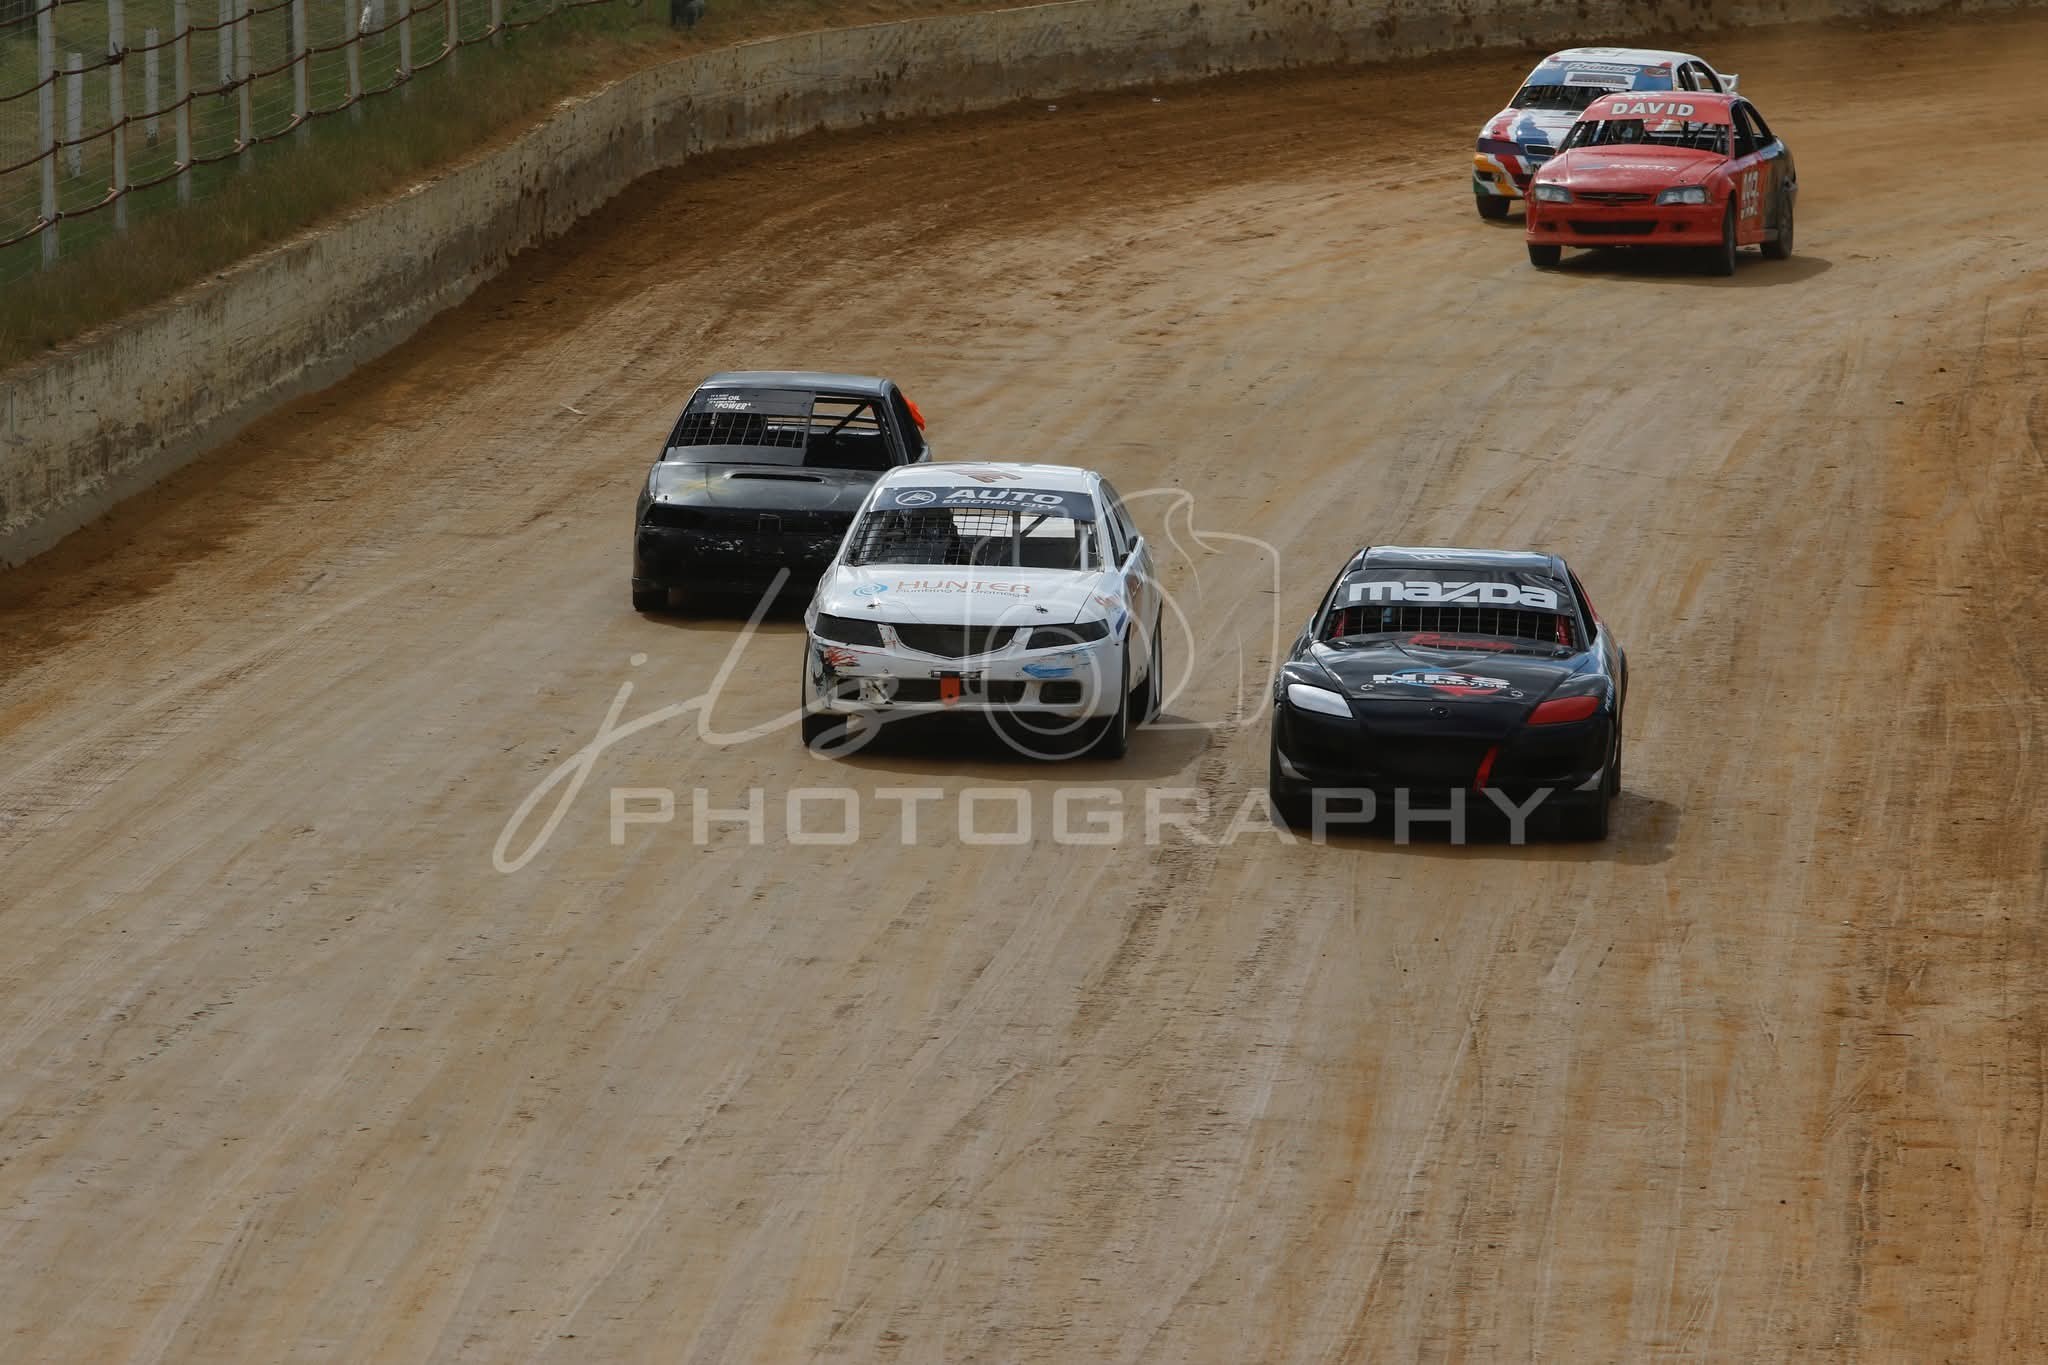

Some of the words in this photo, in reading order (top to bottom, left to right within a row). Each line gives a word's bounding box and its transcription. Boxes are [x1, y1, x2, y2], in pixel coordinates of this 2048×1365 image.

[1611, 102, 1695, 117] DAVID
[945, 488, 1064, 505] AUTO
[942, 499, 1016, 508] ELECTRIC
[1023, 502, 1057, 510] CITY
[896, 580, 1032, 594] HUNTER
